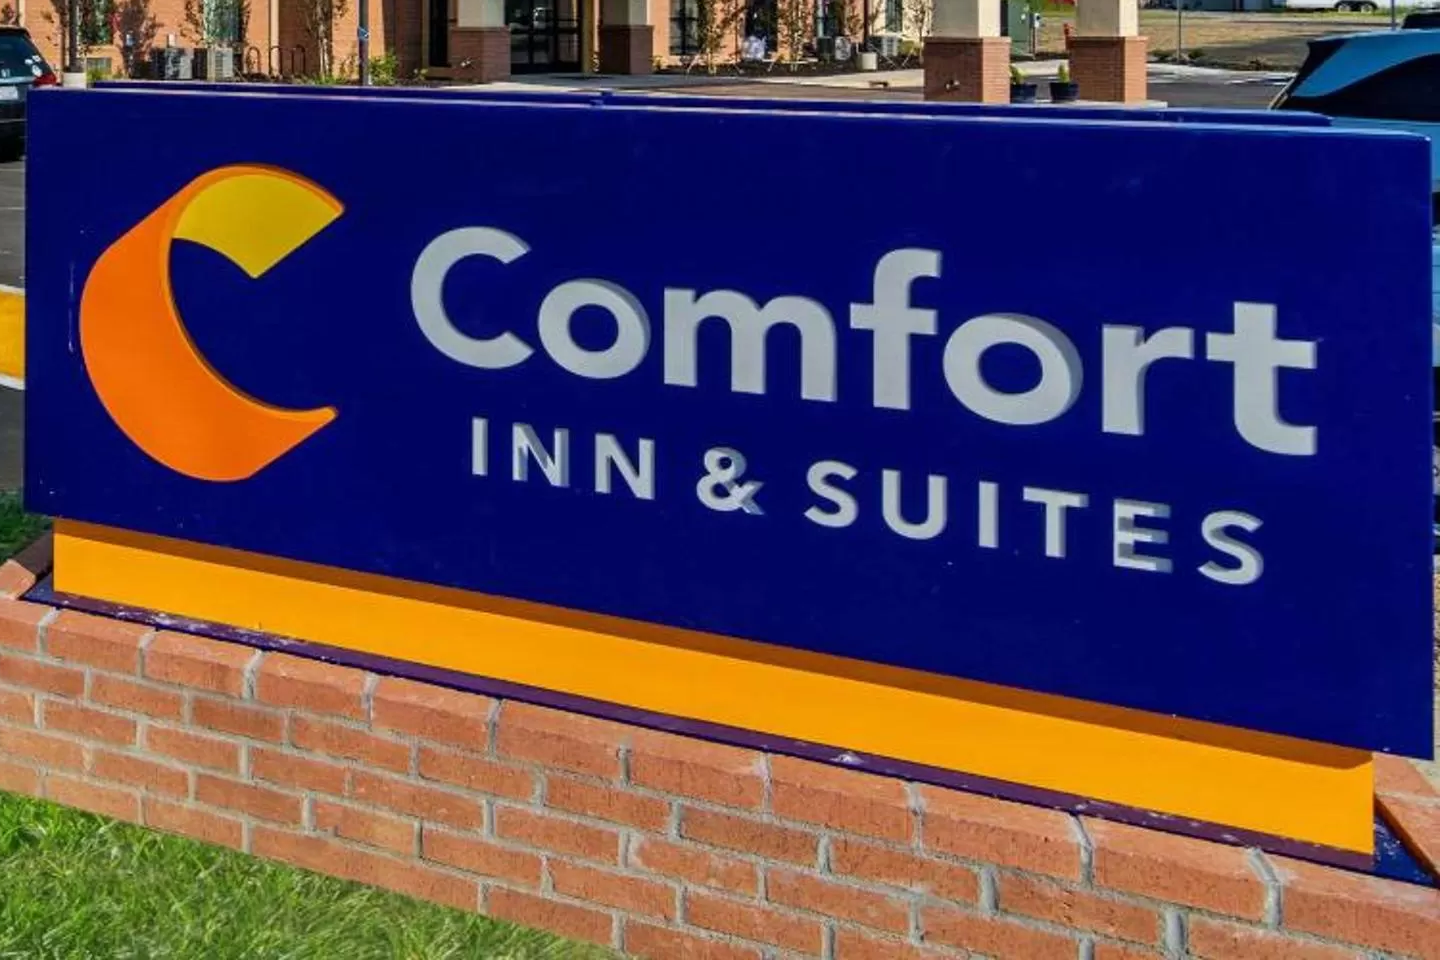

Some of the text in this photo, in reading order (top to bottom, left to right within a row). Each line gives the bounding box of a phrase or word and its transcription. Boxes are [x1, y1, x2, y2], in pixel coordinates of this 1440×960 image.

[411, 226, 1318, 456] Comfort
[471, 416, 1265, 586] INN & SUITES
